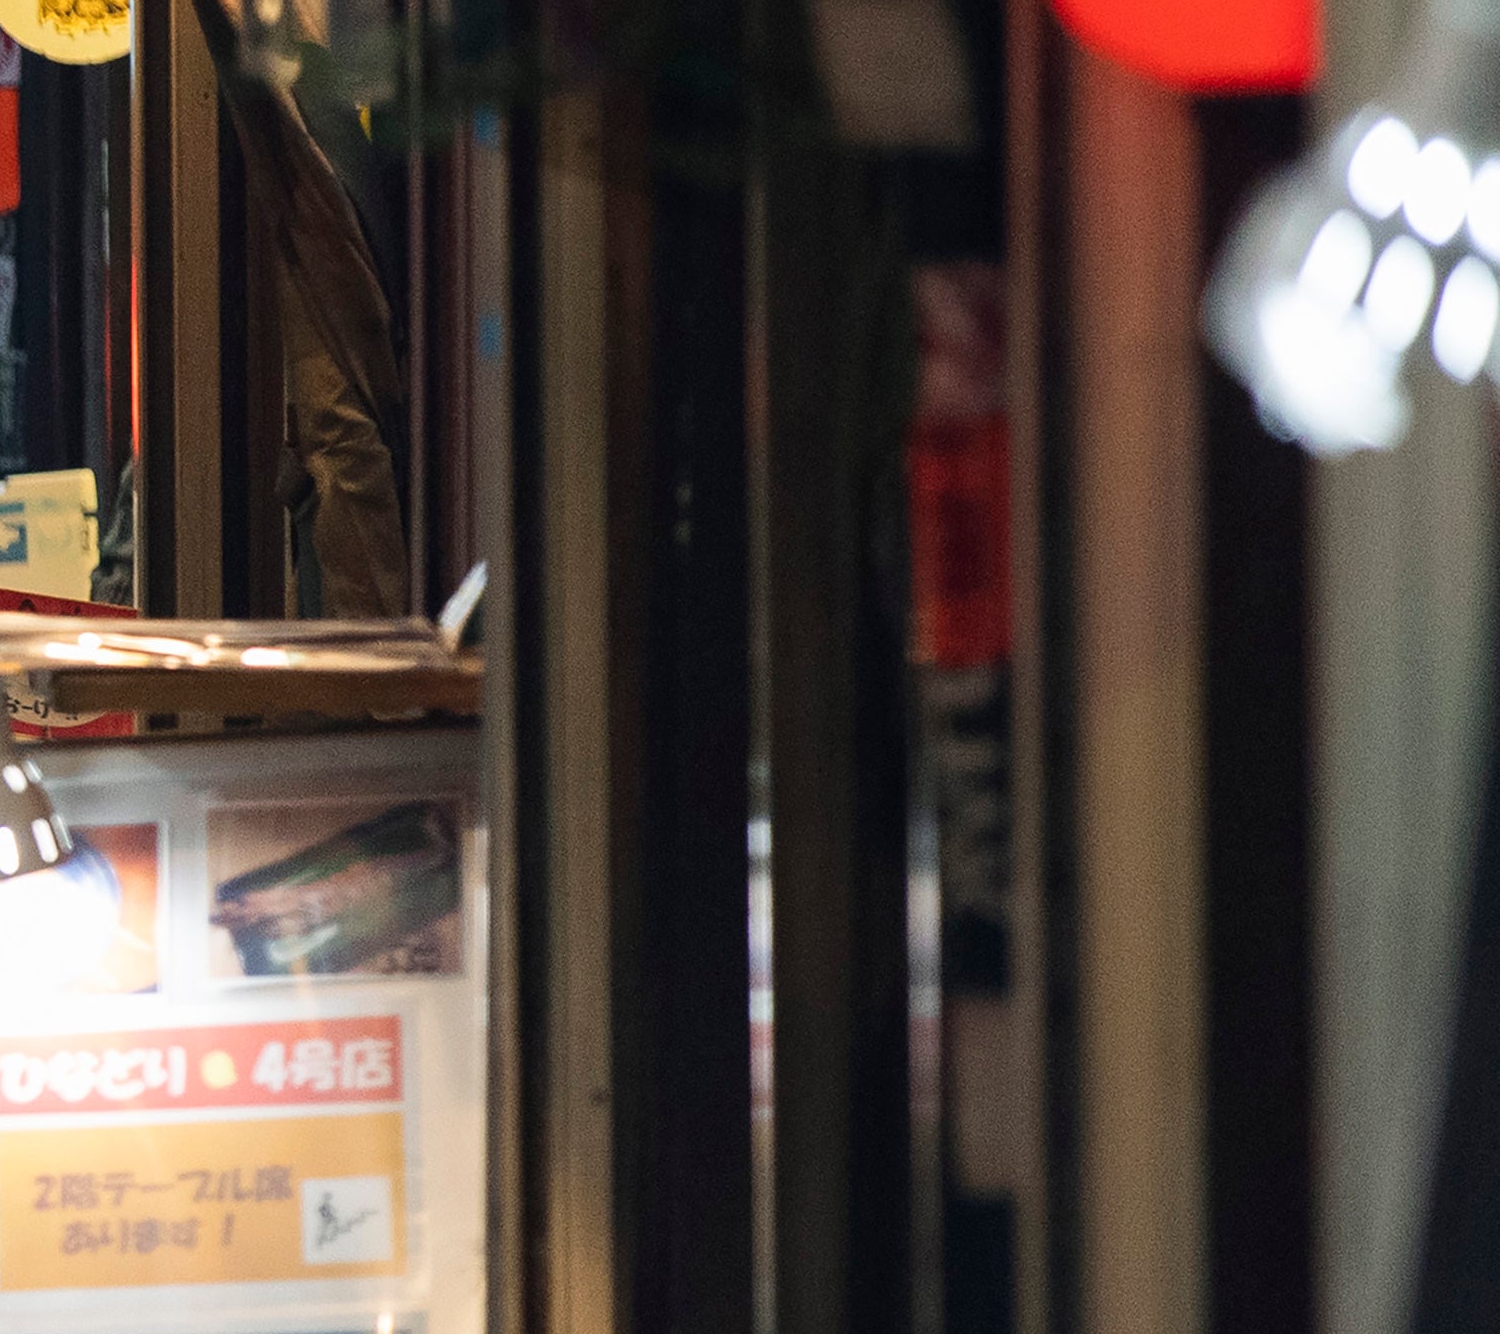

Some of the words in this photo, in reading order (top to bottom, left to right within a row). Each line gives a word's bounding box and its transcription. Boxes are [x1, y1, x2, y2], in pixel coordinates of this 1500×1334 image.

[0, 1045, 188, 1102] ひなどり
[252, 1036, 394, 1094] 4号店
